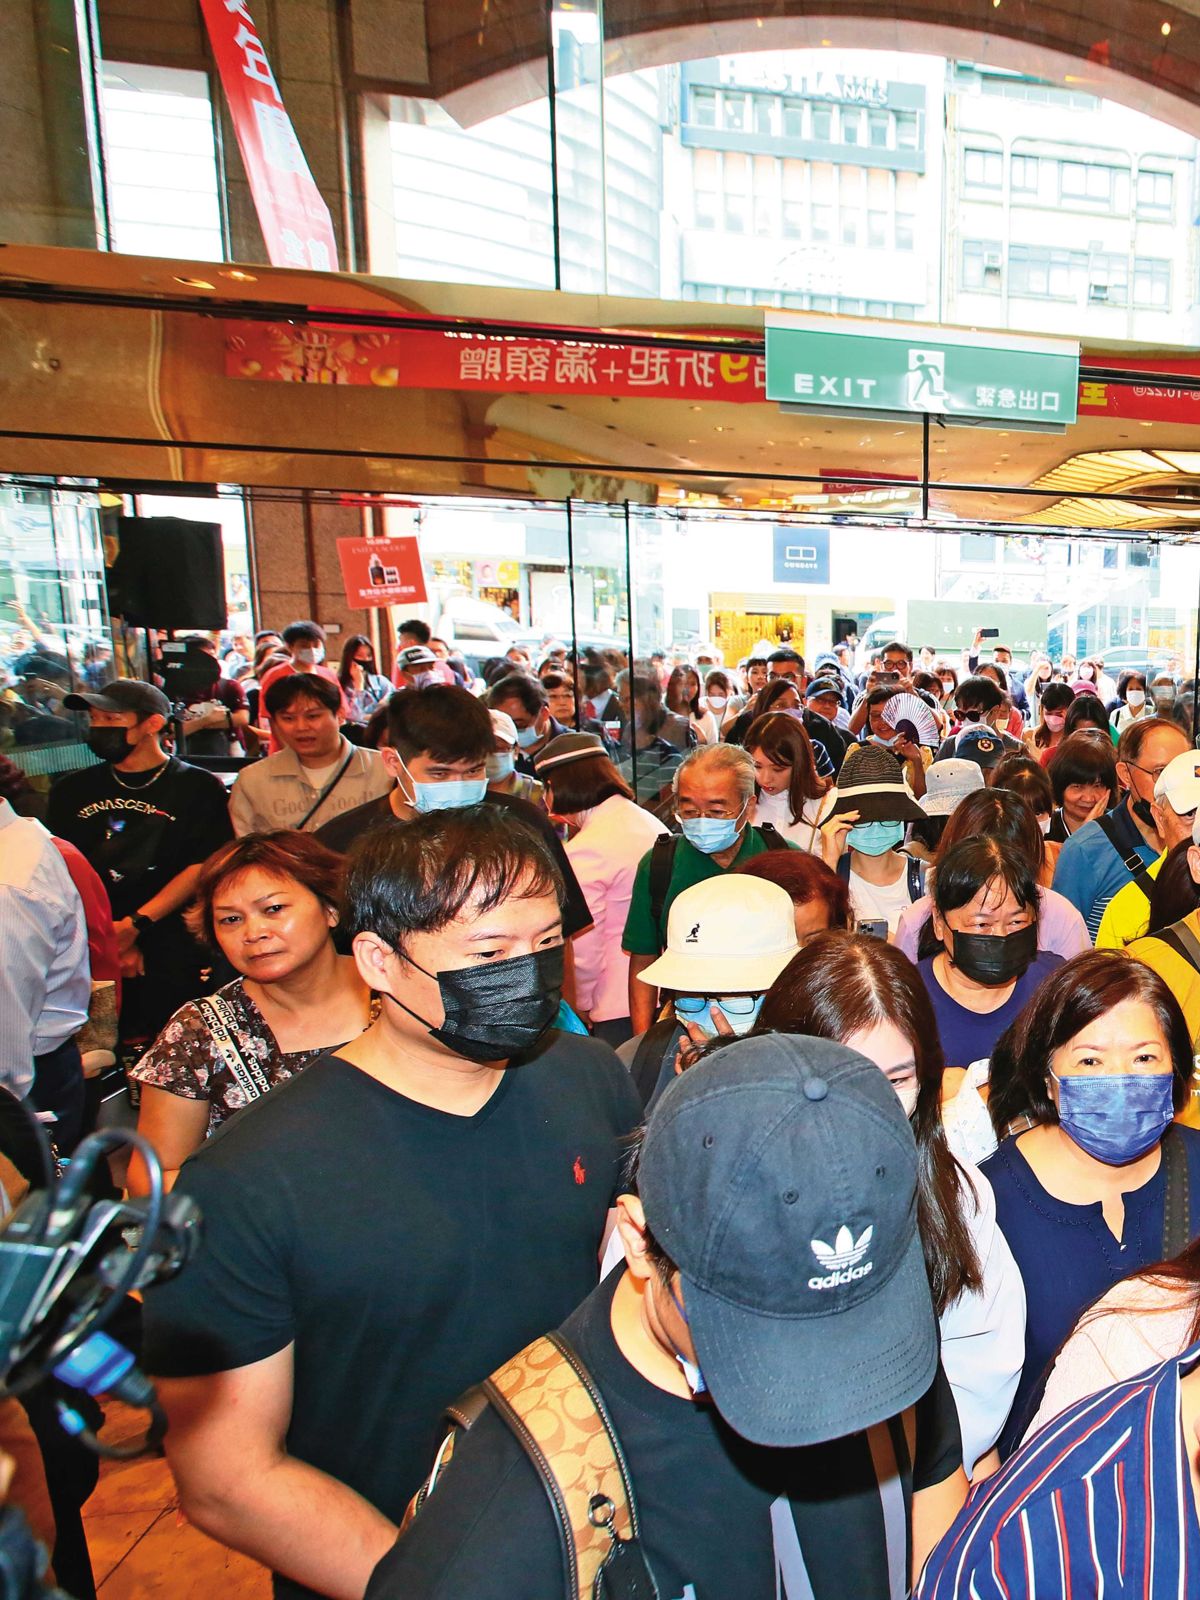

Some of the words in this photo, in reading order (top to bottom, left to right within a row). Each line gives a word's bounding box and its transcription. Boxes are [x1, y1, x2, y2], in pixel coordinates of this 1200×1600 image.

[842, 84, 888, 104] NAILS
[794, 373, 877, 399] EXIT
[975, 385, 1061, 413] 緊急出口
[234, 1063, 258, 1099] adidas
[248, 1057, 271, 1093] adidas
[808, 1261, 873, 1290] adidas
